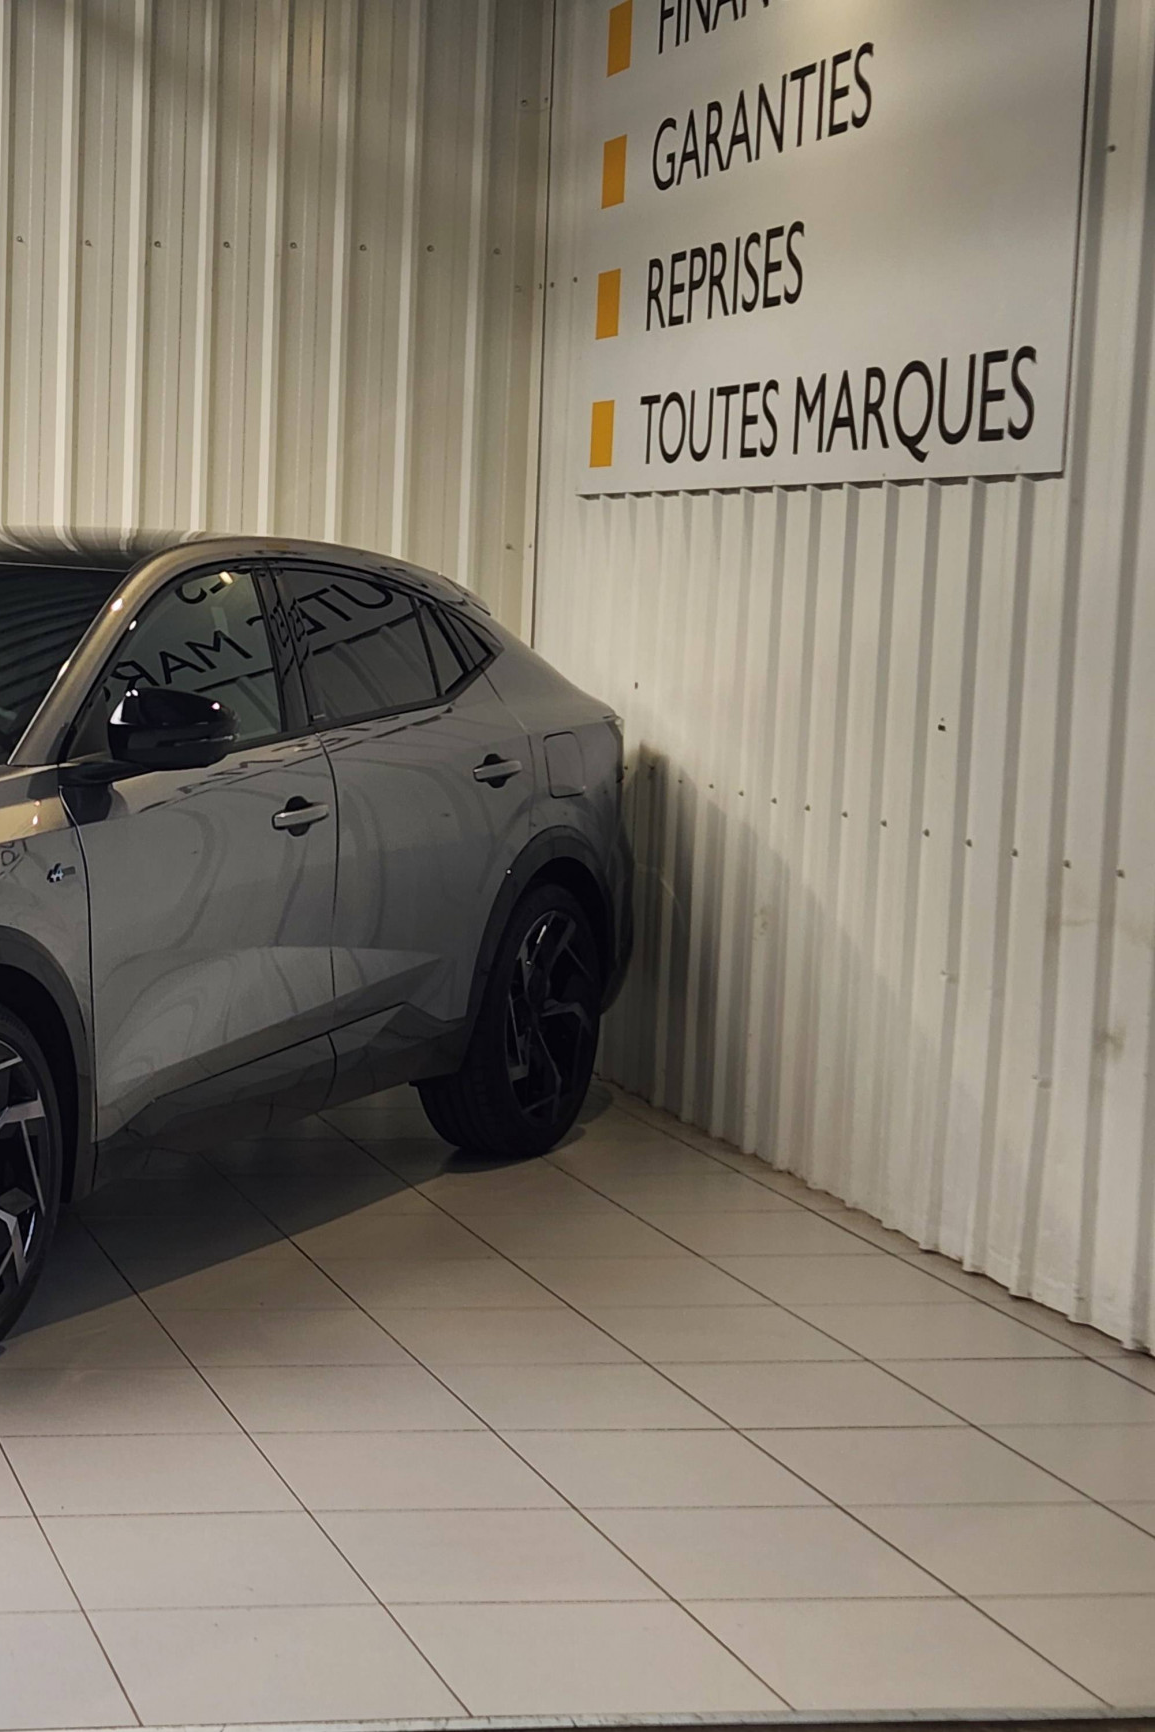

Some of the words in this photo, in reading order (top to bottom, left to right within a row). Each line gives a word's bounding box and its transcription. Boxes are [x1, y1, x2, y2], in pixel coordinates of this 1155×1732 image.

[652, 41, 874, 191] GARANTIES
[645, 220, 805, 332] REPRISES
[640, 379, 779, 465] TOUTES
[792, 345, 1037, 464] MARQUES
